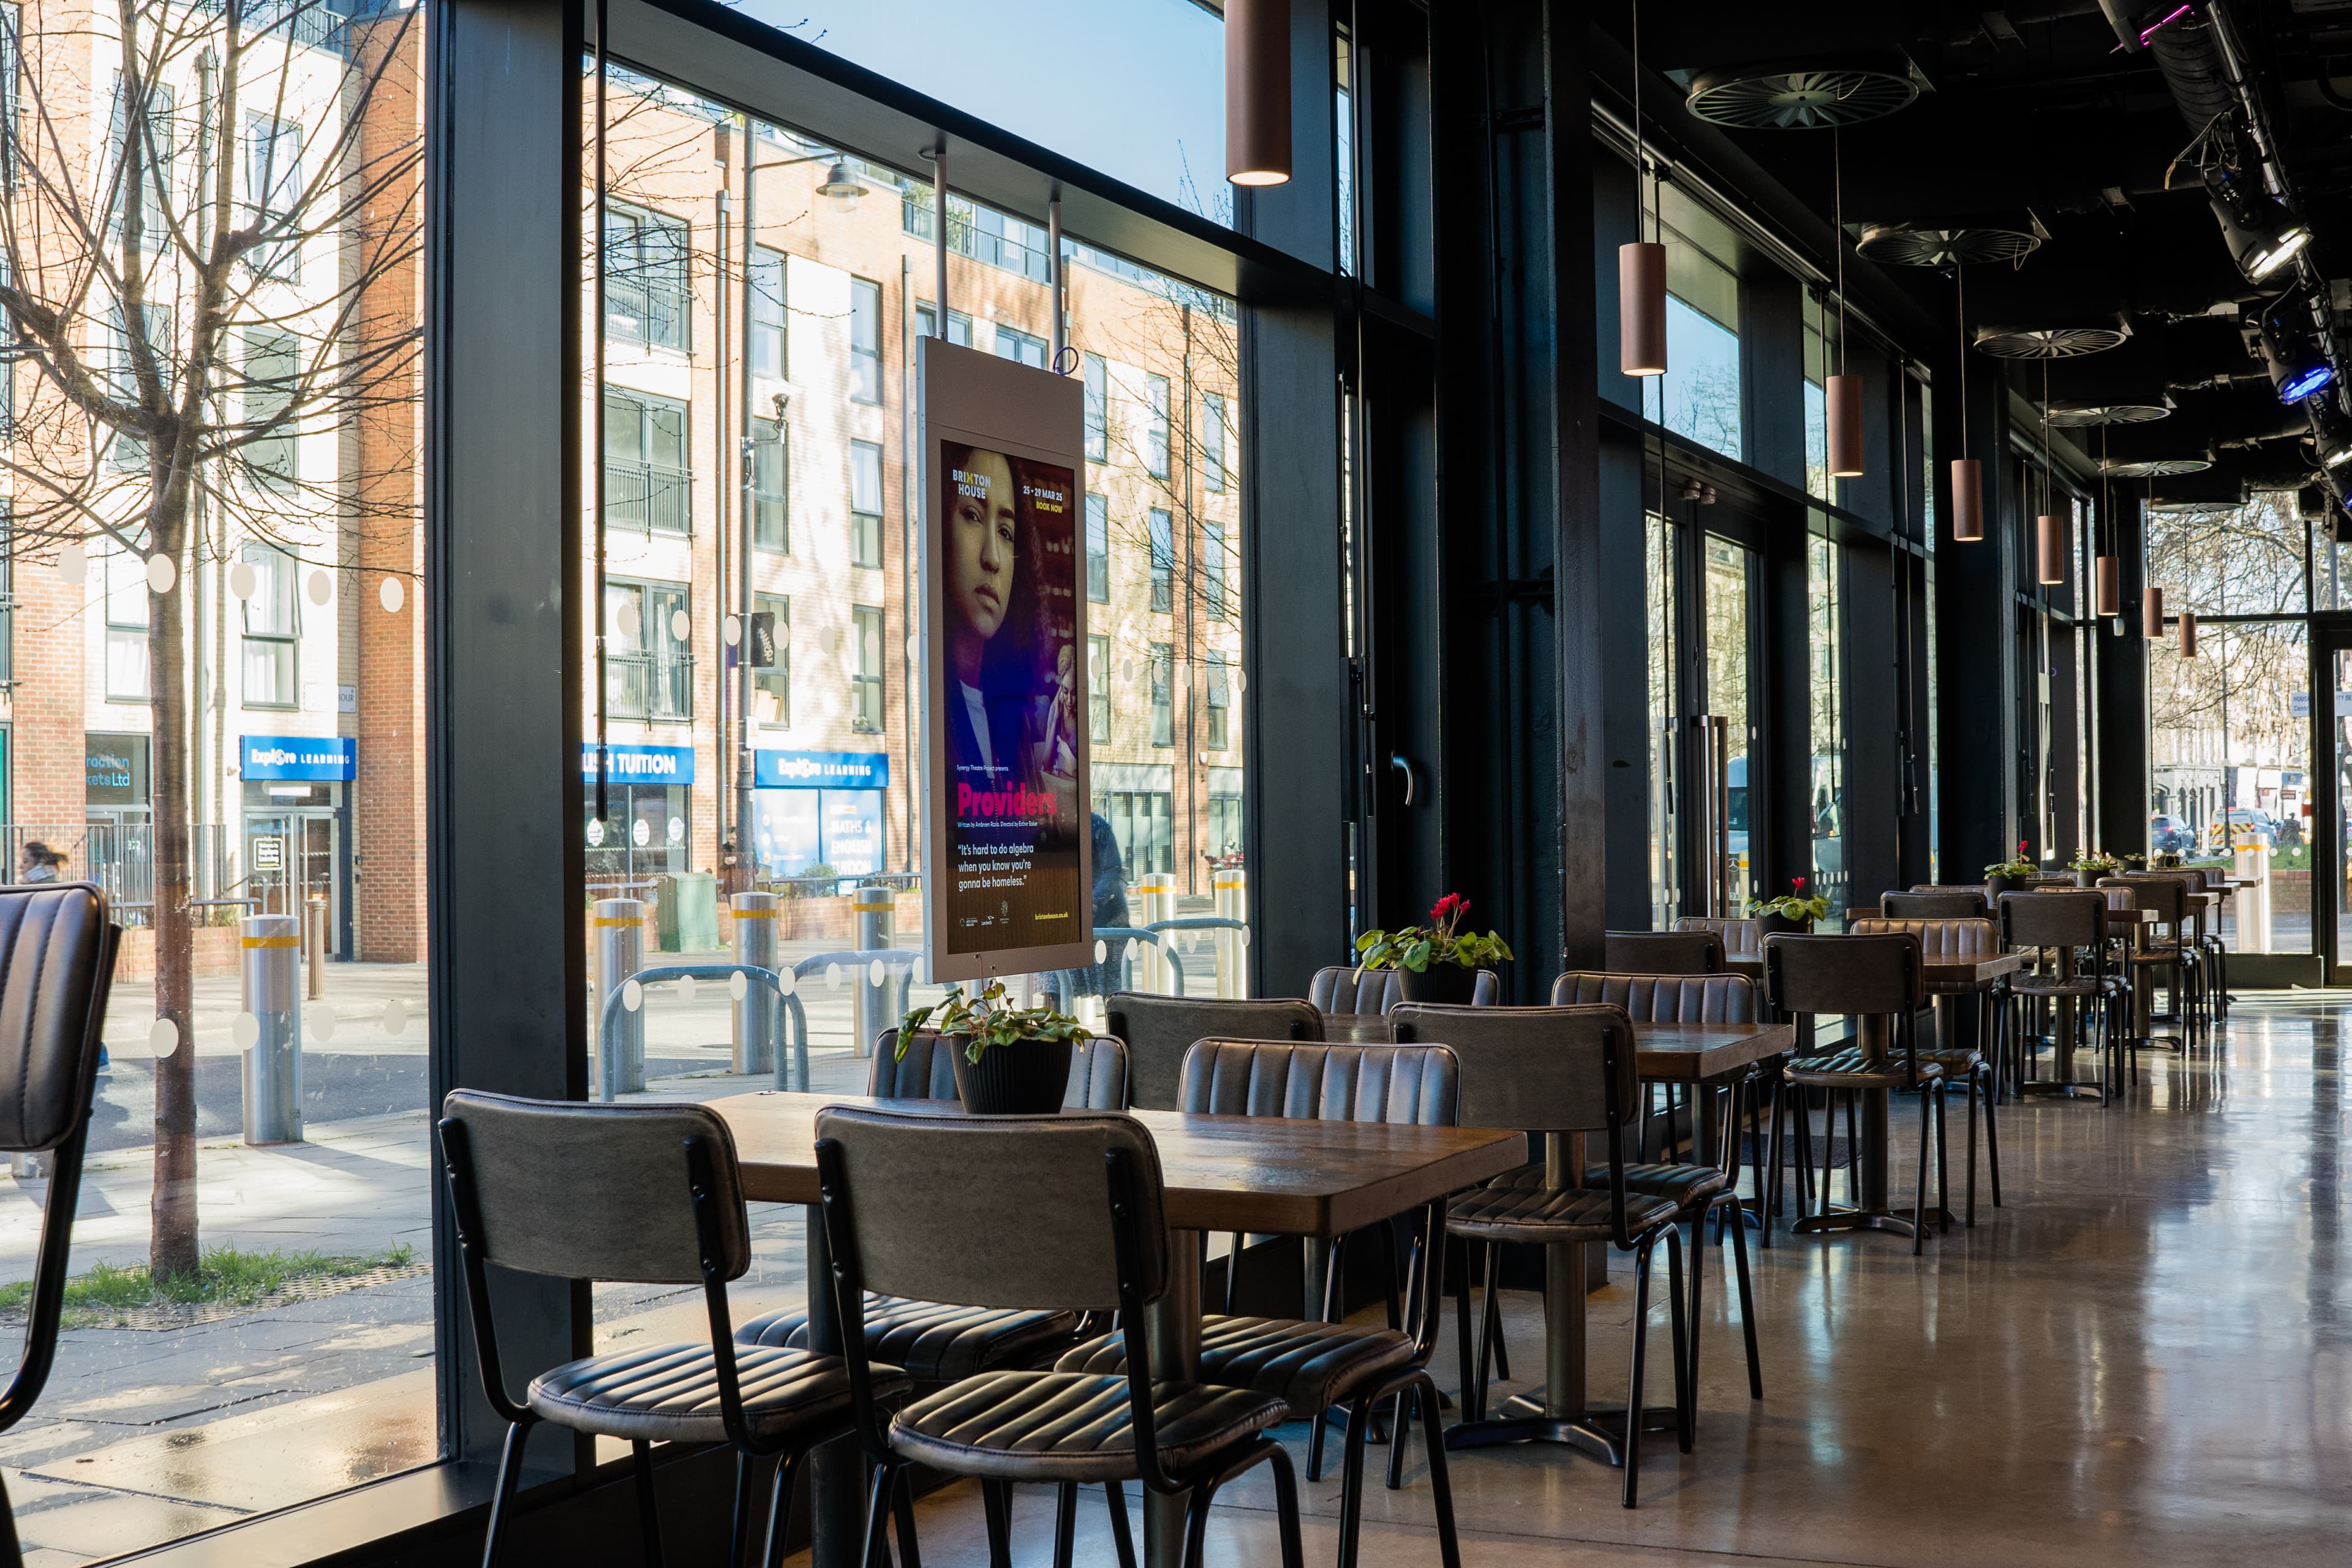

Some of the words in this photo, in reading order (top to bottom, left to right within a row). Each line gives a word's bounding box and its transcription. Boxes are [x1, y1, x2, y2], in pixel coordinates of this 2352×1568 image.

[952, 469, 991, 488] BRIXTON
[958, 483, 986, 500] HOUSE
[1023, 485, 1030, 495] 25
[1035, 488, 1041, 497] 29
[1042, 489, 1055, 500] MAR
[1056, 492, 1063, 502] 25
[1036, 501, 1050, 511] BOOK
[1050, 503, 1063, 514] NOW
[251, 748, 297, 767] Explore
[301, 754, 350, 764] LEARNING
[617, 753, 676, 774] TUITION
[824, 764, 871, 776] LEARNING
[111, 772, 130, 786] Ltd
[957, 780, 1057, 816] Providers
[831, 820, 863, 834] MATHS
[973, 843, 989, 855] hard
[990, 845, 997, 854] to
[998, 843, 1008, 854] do
[1009, 843, 1034, 856] algebra
[958, 861, 977, 872] when
[979, 862, 991, 875] you
[992, 859, 1010, 872] know
[959, 878, 981, 892] gonna
[982, 876, 991, 888] be
